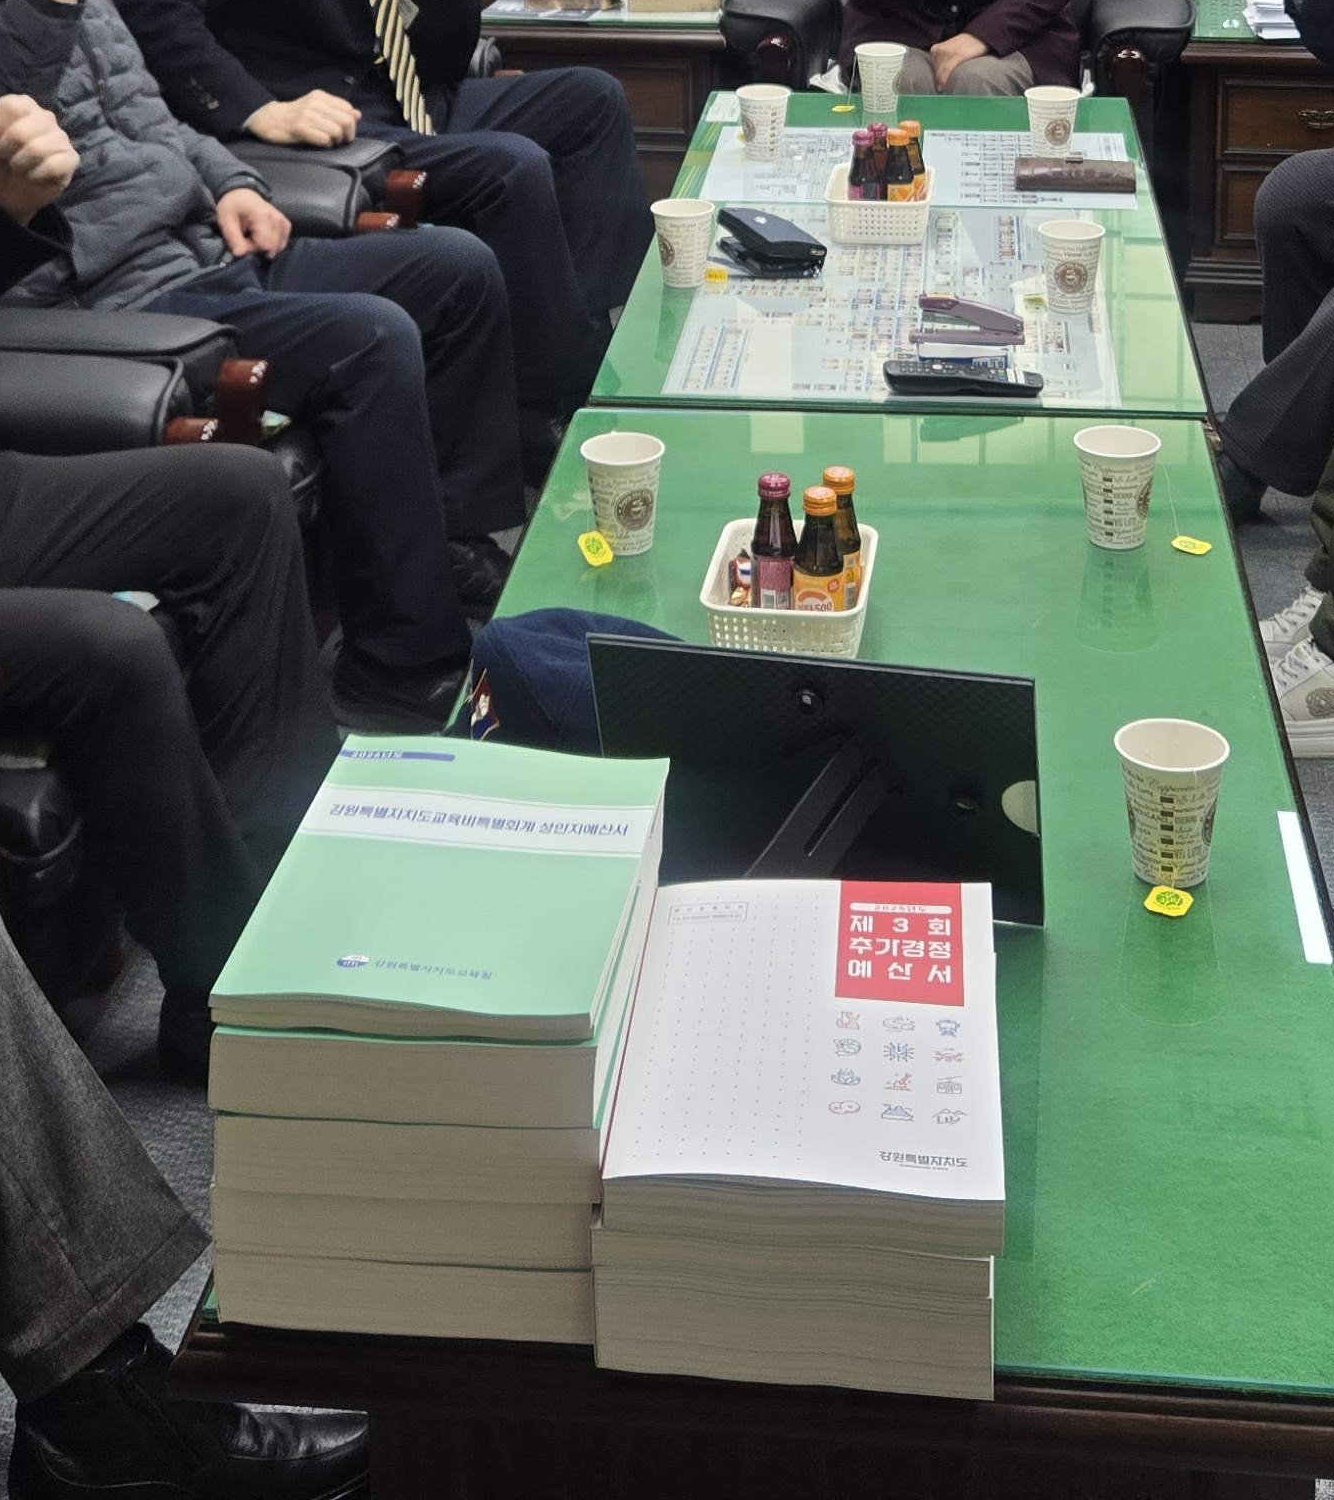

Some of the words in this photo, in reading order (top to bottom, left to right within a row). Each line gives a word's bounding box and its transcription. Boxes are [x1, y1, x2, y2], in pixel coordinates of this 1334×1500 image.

[329, 803, 537, 832] 강원특별자치도교육비특별회계
[539, 821, 629, 837] 성인지예산서
[850, 914, 874, 933] 제
[892, 917, 909, 933] 3
[928, 917, 951, 936] 회
[849, 936, 951, 959] 추가경정
[847, 959, 872, 979] 예
[888, 962, 913, 980] 산
[927, 964, 951, 983] 서
[879, 1150, 968, 1168] 강원특별자치도
